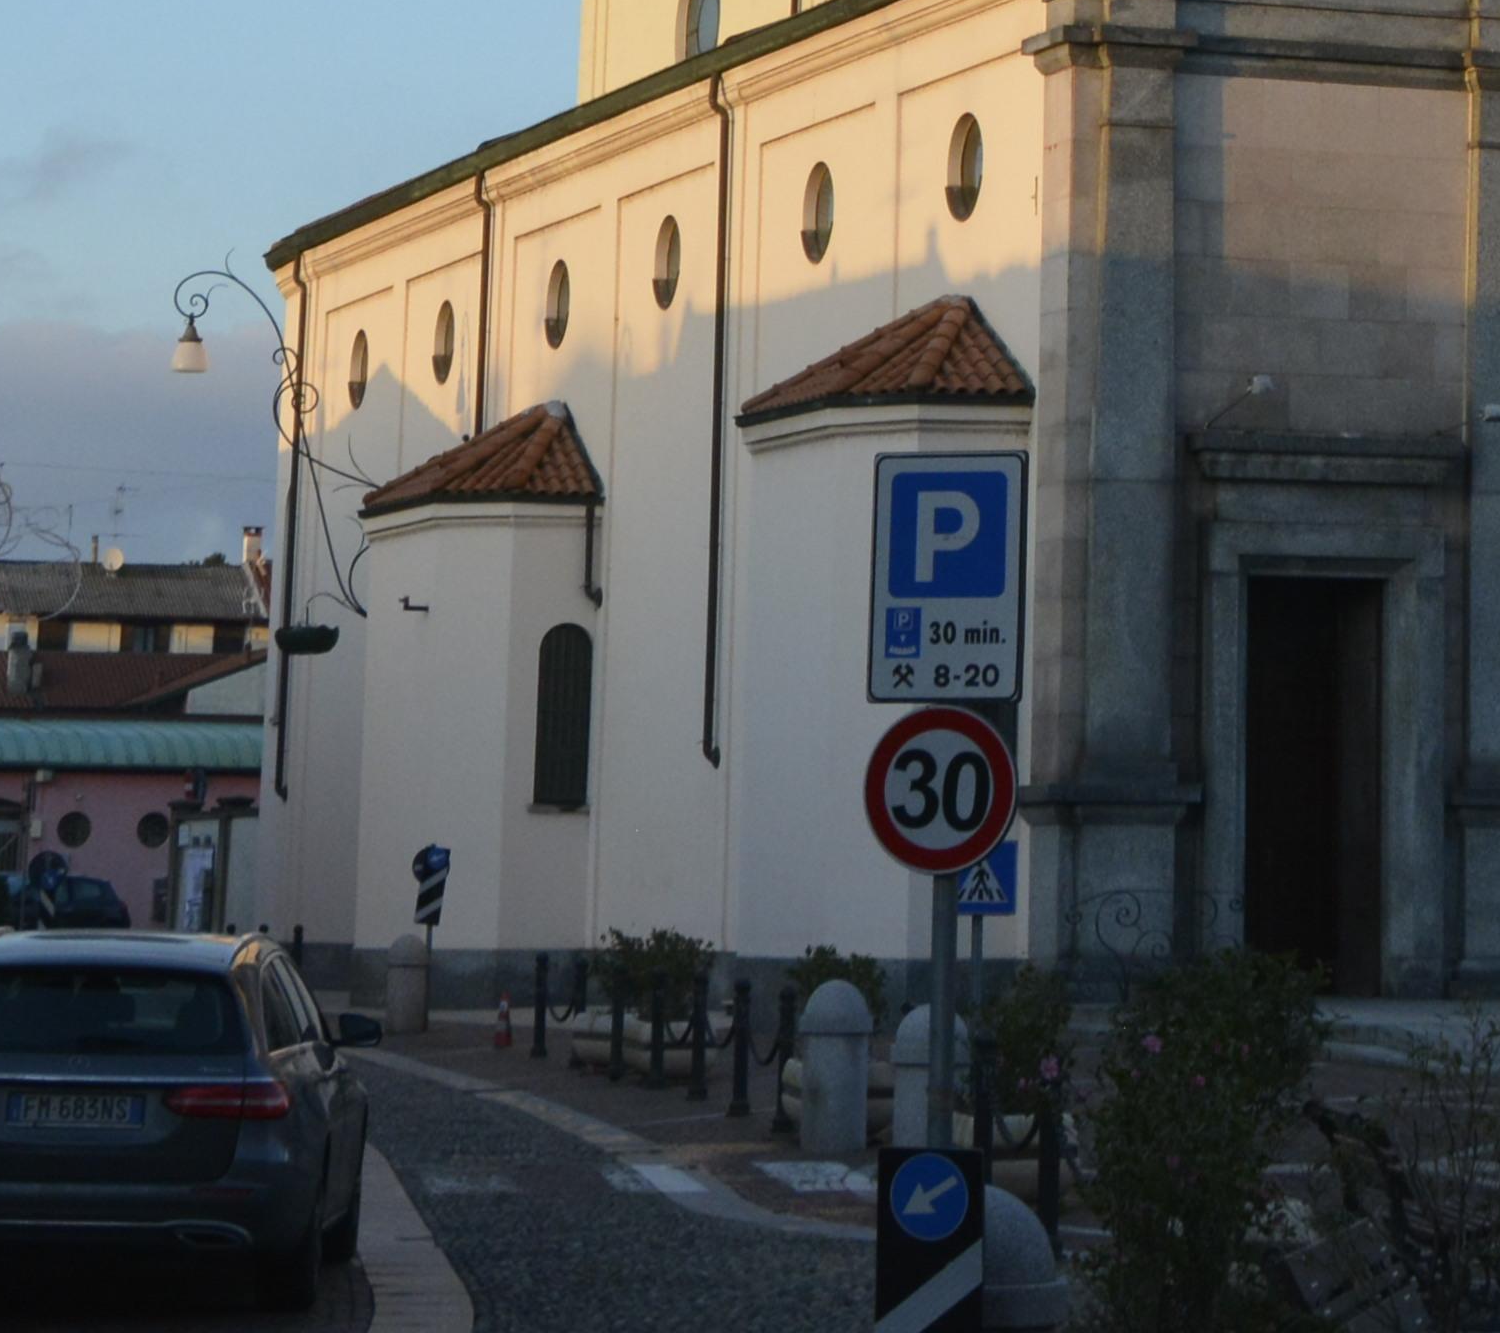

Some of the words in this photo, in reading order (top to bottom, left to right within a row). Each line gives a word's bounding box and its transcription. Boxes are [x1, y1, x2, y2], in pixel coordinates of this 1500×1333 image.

[914, 490, 981, 584] P
[898, 612, 909, 627] P
[929, 621, 956, 645] 30
[964, 619, 1006, 644] min.
[934, 663, 1000, 688] 8-20
[892, 748, 991, 832] 30
[23, 1098, 51, 1120] FM
[58, 1098, 128, 1120] 683NS
